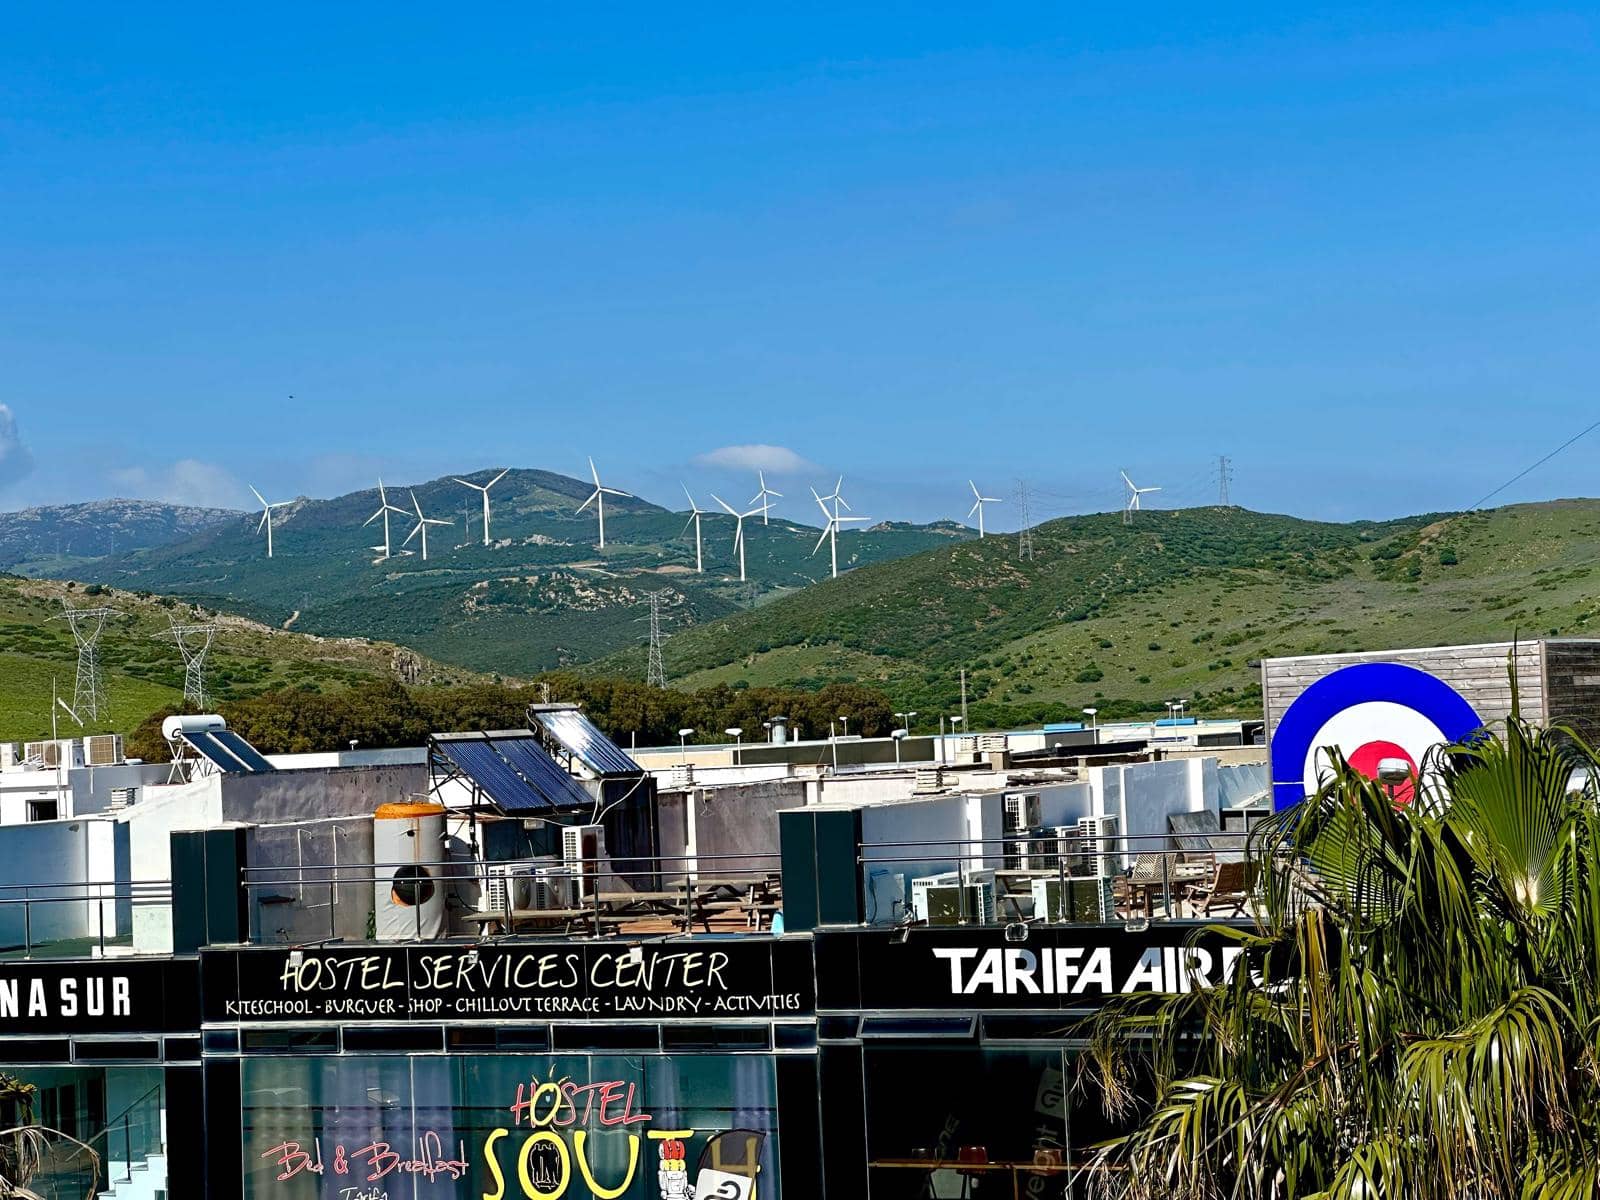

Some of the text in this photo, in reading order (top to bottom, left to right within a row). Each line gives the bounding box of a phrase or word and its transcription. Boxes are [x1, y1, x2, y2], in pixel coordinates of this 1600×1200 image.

[280, 952, 729, 992] HOSTEL SERVICES CENTER
[932, 947, 1113, 994] TARIFA
[1120, 946, 1215, 994] AIR
[225, 1000, 313, 1015] KITESCHOOL
[325, 999, 396, 1015] BURGUER
[407, 998, 443, 1014] SHOP
[615, 996, 702, 1013] LAUNDRY
[713, 993, 801, 1011] ACTIVITIES
[510, 1080, 653, 1129] HOSTEL
[261, 1130, 470, 1184] Bed & Breakfast
